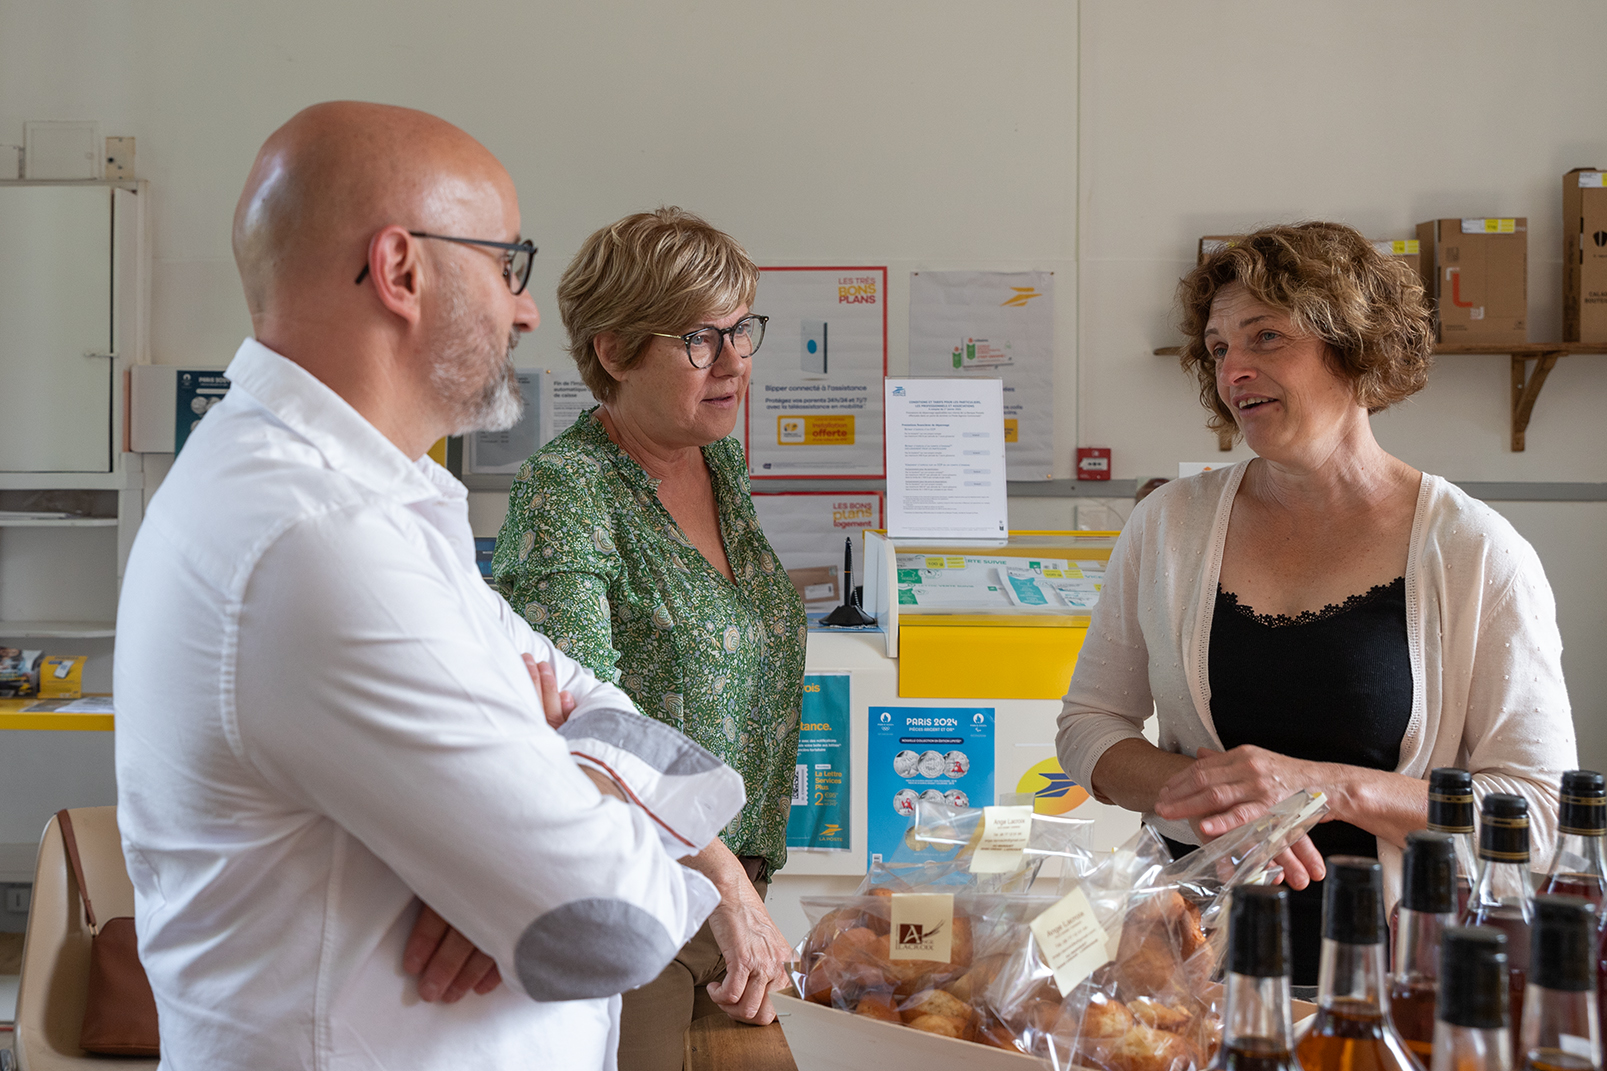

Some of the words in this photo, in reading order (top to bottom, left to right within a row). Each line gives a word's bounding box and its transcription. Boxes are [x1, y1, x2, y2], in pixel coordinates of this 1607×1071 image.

[838, 277, 854, 285] LES
[856, 276, 876, 285] TRÈS
[838, 283, 876, 297] BONS
[838, 295, 876, 304] PLANS
[833, 508, 873, 521] plans
[833, 520, 872, 529] logement
[800, 722, 832, 731] tance.
[906, 718, 932, 726] PARIS
[934, 718, 958, 726] 2024
[814, 792, 824, 806] 2
